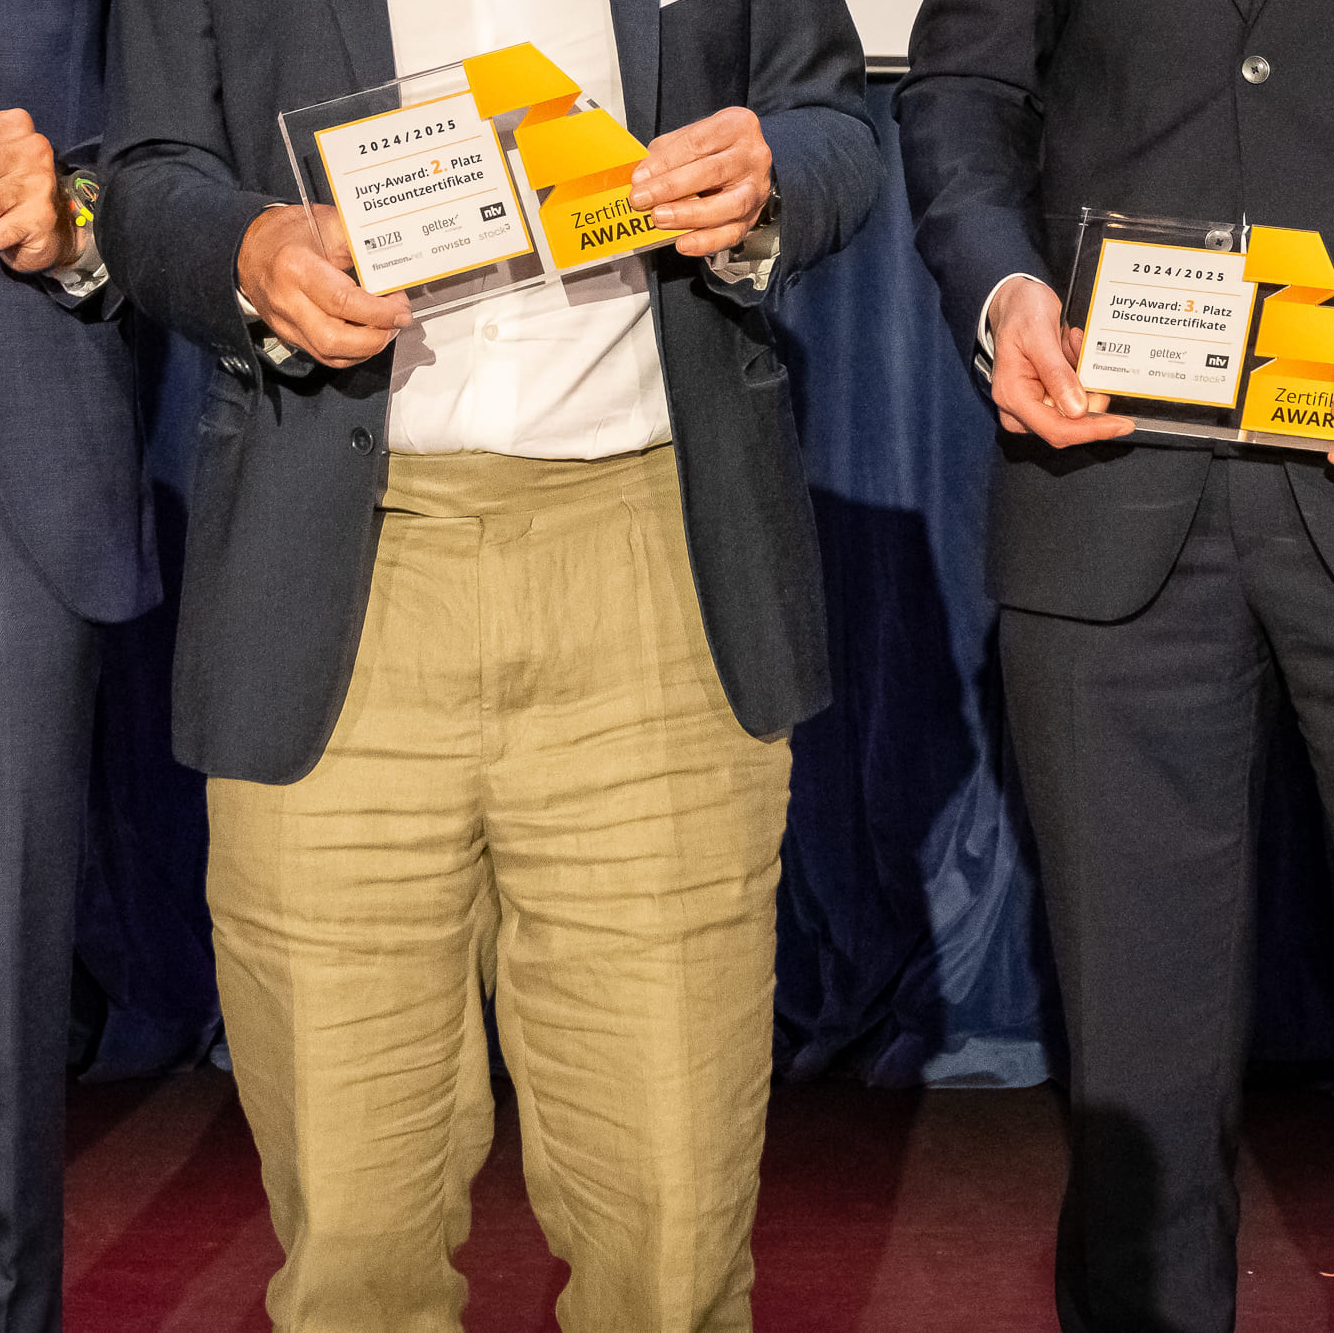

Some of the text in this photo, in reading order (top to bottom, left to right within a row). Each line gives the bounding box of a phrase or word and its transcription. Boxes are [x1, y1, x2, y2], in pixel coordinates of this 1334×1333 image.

[358, 119, 456, 155] 2024/2025
[355, 153, 483, 199] Jury-Award: 2. Platz
[363, 169, 484, 212] Discountzertifikate
[571, 197, 633, 229] Zertifi
[377, 231, 403, 248] DZB
[581, 213, 657, 251] AWARD
[431, 237, 471, 255] onvista
[1132, 263, 1225, 282] 2024/2025
[1110, 295, 1232, 318] Jury-Award: 3. Platz
[1111, 309, 1227, 332] Discountzertifikate
[1108, 342, 1131, 355] DZB
[1148, 369, 1187, 380] onvista
